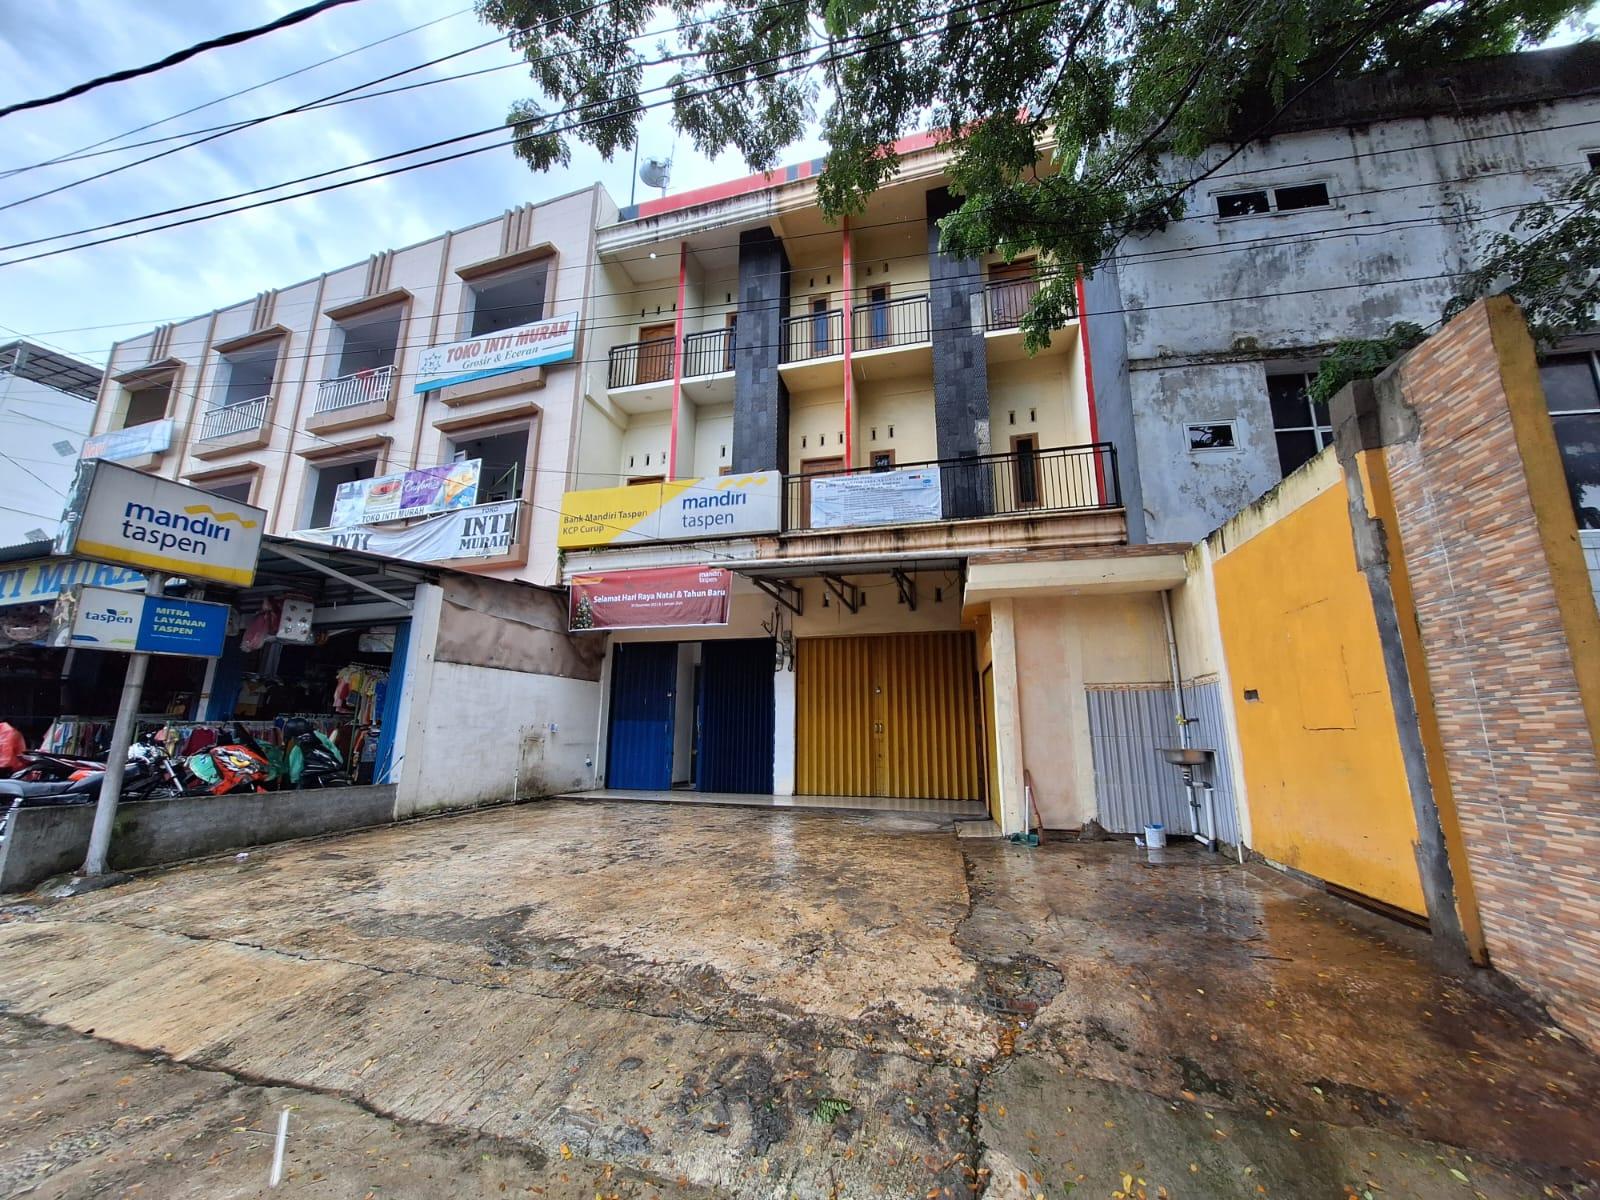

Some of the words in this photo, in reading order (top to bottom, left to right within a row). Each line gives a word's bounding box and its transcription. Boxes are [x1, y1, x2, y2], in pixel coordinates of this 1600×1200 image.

[446, 342, 481, 363] TOKO
[484, 333, 513, 354] INTI
[515, 321, 570, 346] MURAH
[462, 356, 492, 369] Grosir
[493, 354, 501, 362] &
[504, 346, 539, 360] Eceran
[682, 490, 746, 510] mandiri
[362, 511, 381, 523] TOKO
[382, 510, 397, 521] INTI
[399, 507, 425, 518] MURAH
[482, 506, 499, 514] TOKO
[563, 514, 584, 524] Bank
[585, 511, 617, 522] Mandiri
[618, 510, 648, 520] Taspen
[125, 502, 230, 541] mandiri
[461, 512, 513, 537] INTI
[682, 513, 734, 530] taspen
[122, 520, 207, 555] taspen
[562, 526, 579, 535] KCP
[580, 525, 605, 534] Curup
[459, 534, 509, 551] MURAH
[593, 595, 621, 604] Selamat
[622, 593, 637, 602] Hari
[638, 593, 655, 602] Raya
[656, 591, 675, 600] Natal
[676, 591, 683, 599] &
[684, 590, 706, 599] Tahun
[707, 589, 726, 597] Baru
[85, 610, 133, 624] taspen
[155, 607, 190, 618] MITRA
[153, 625, 193, 635] TASPEN
[154, 616, 206, 628] LAYANAN
